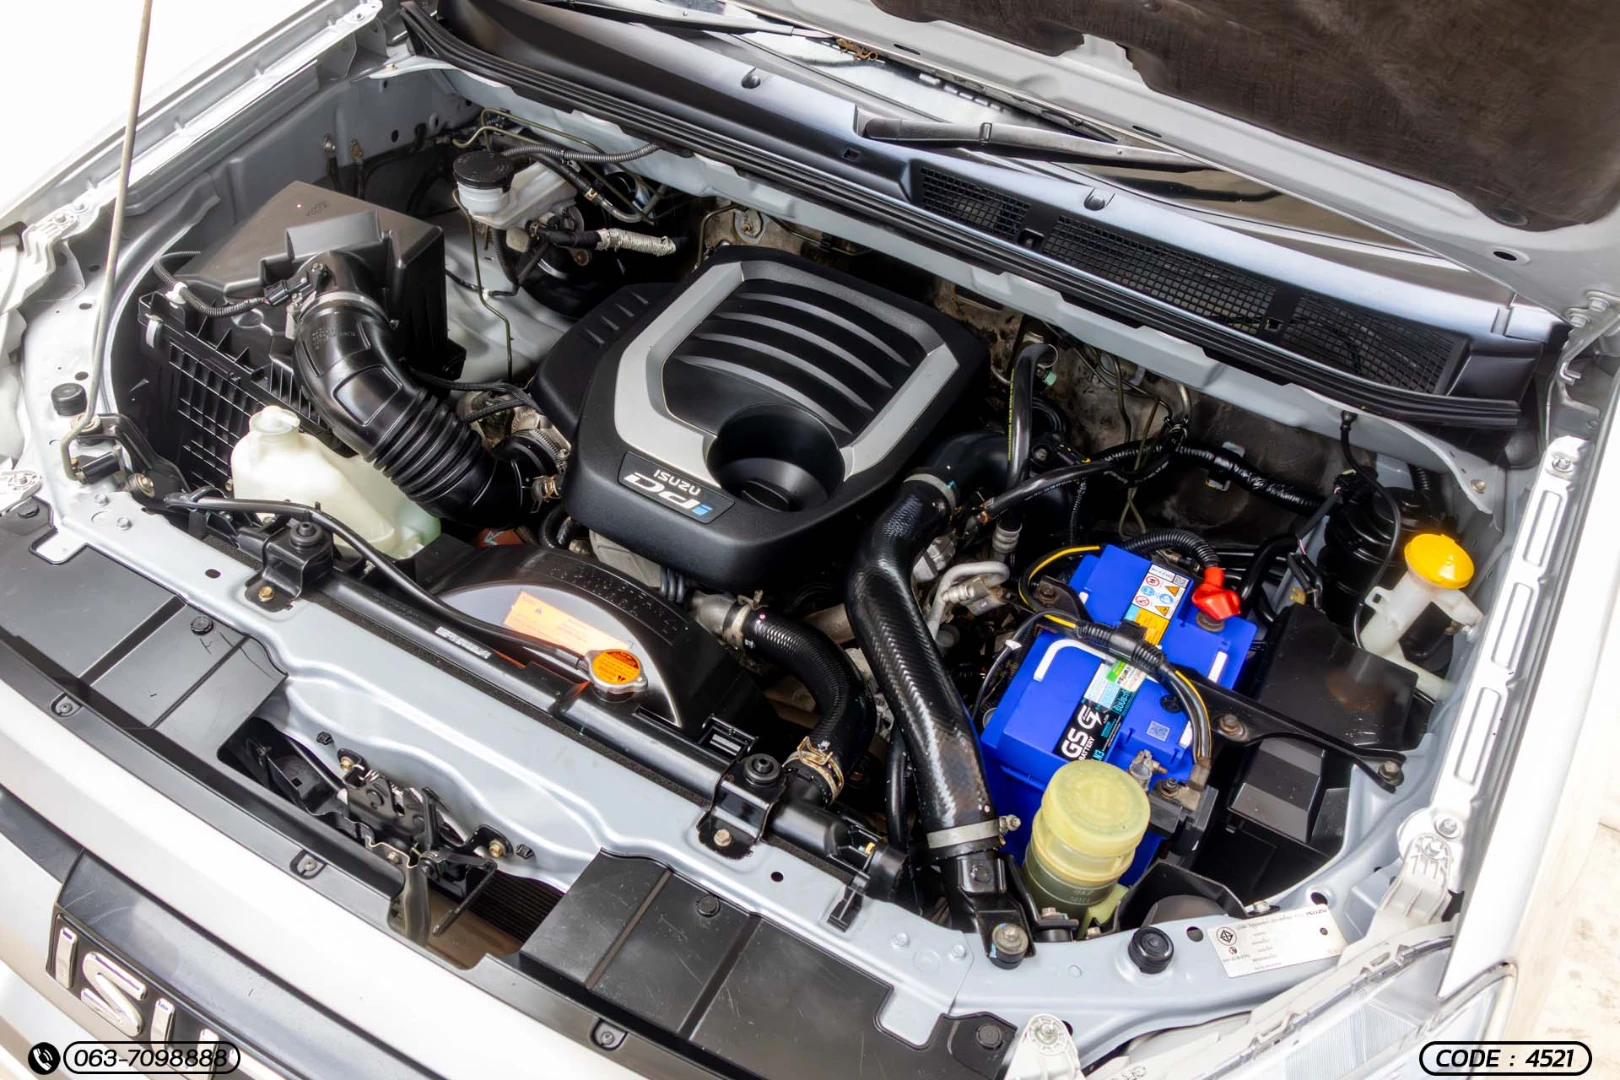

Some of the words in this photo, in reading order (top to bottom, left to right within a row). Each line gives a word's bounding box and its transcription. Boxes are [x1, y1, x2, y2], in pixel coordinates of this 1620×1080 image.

[653, 469, 701, 496] ISUZU
[1061, 727, 1089, 759] GS
[55, 927, 284, 1080] ISU
